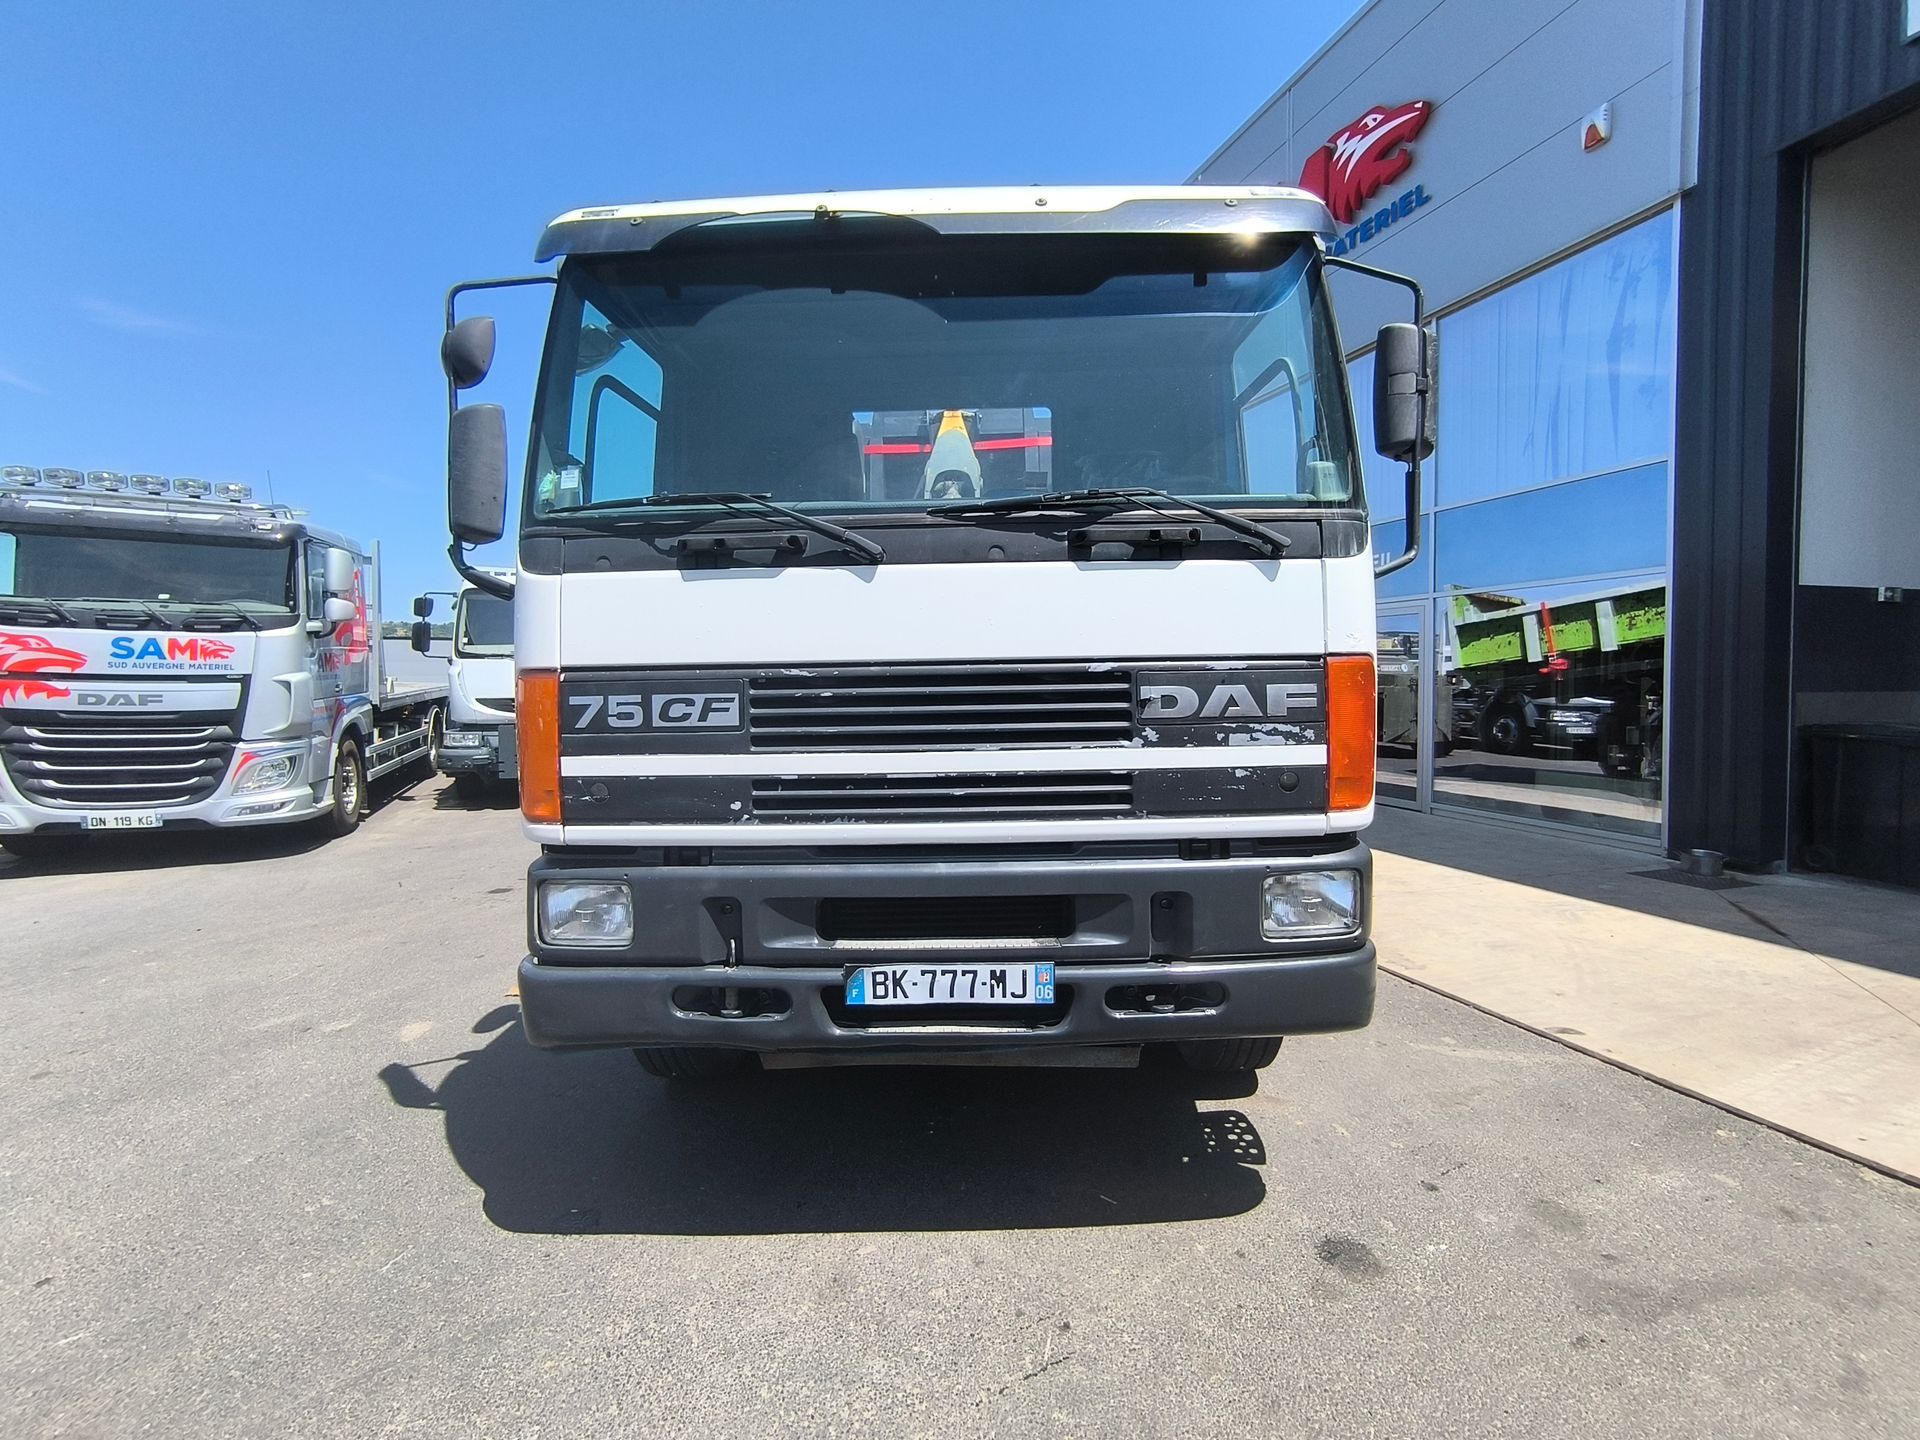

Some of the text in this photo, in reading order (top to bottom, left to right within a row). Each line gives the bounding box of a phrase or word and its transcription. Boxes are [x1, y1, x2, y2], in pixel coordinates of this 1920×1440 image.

[110, 636, 198, 661] SAM
[131, 662, 185, 670] AUVERGNE
[188, 663, 234, 671] MATERIEL
[77, 693, 164, 706] DAF
[1139, 684, 1318, 718] DAF
[568, 694, 736, 729] 75 CF
[871, 968, 1028, 999] BK-777-MJ
[1036, 985, 1053, 998] 06
[852, 989, 858, 998] F
